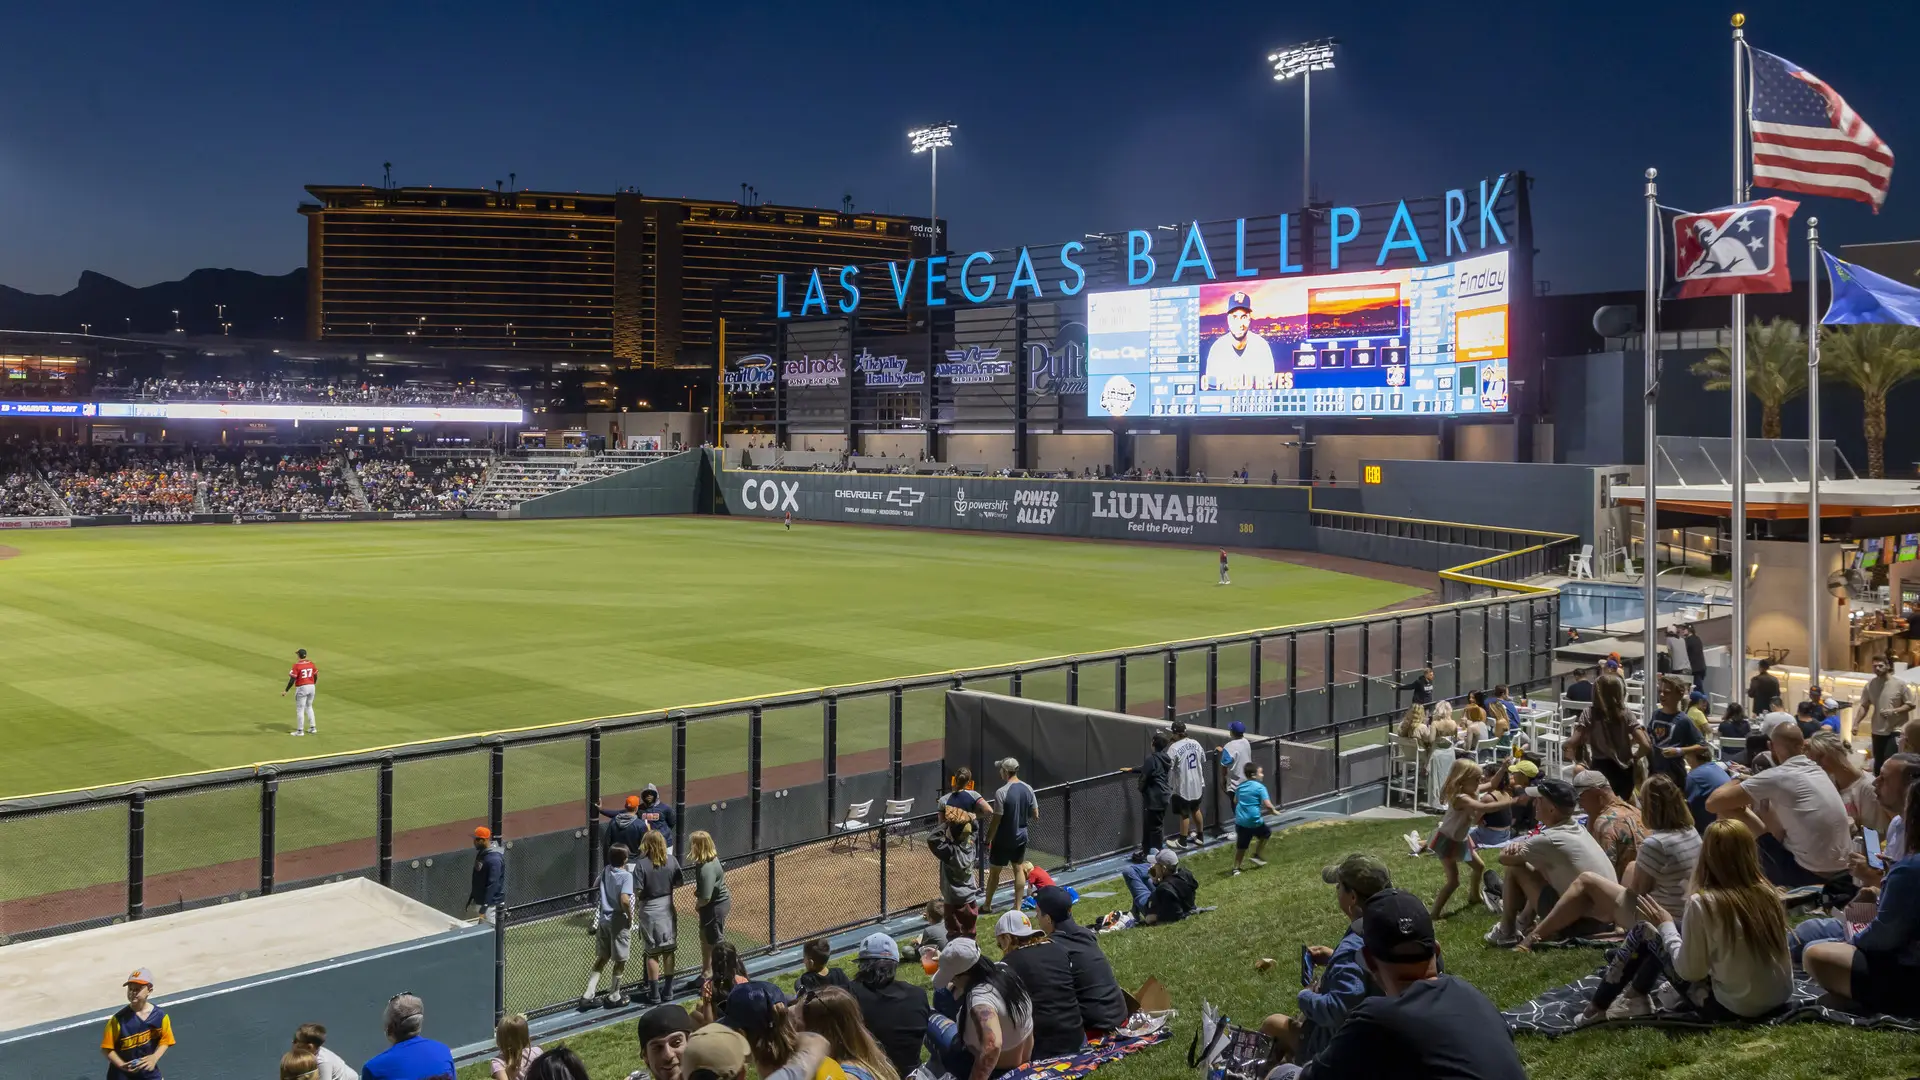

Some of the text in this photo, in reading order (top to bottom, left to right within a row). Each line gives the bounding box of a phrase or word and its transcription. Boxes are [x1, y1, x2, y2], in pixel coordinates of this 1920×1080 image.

[924, 226, 941, 234] rok
[777, 172, 1508, 318] LAS VEGAS BALLPARK
[1459, 268, 1507, 293] Findlay
[784, 353, 842, 375] red rock
[865, 354, 907, 374] The Valley
[934, 361, 1012, 377] AMERICA FIRST
[865, 371, 924, 387] Health System
[1255, 372, 1294, 389] REYES
[52, 405, 78, 413] NIGHT
[741, 478, 799, 512] COX
[834, 489, 883, 500] CHEVROLET
[1013, 489, 1059, 508] POWER
[1196, 496, 1218, 507] LOCAL
[968, 500, 1009, 512] powershift
[1092, 490, 1194, 523] LiUNA!
[131, 513, 193, 522] HANRATTY
[256, 512, 276, 521] Clips
[1016, 507, 1056, 525] ALLEY
[1196, 506, 1218, 524] 872
[1127, 521, 1194, 535] Feel the Power!
[1239, 523, 1254, 534] 380
[301, 668, 313, 679] 37
[1186, 753, 1197, 770] 12
